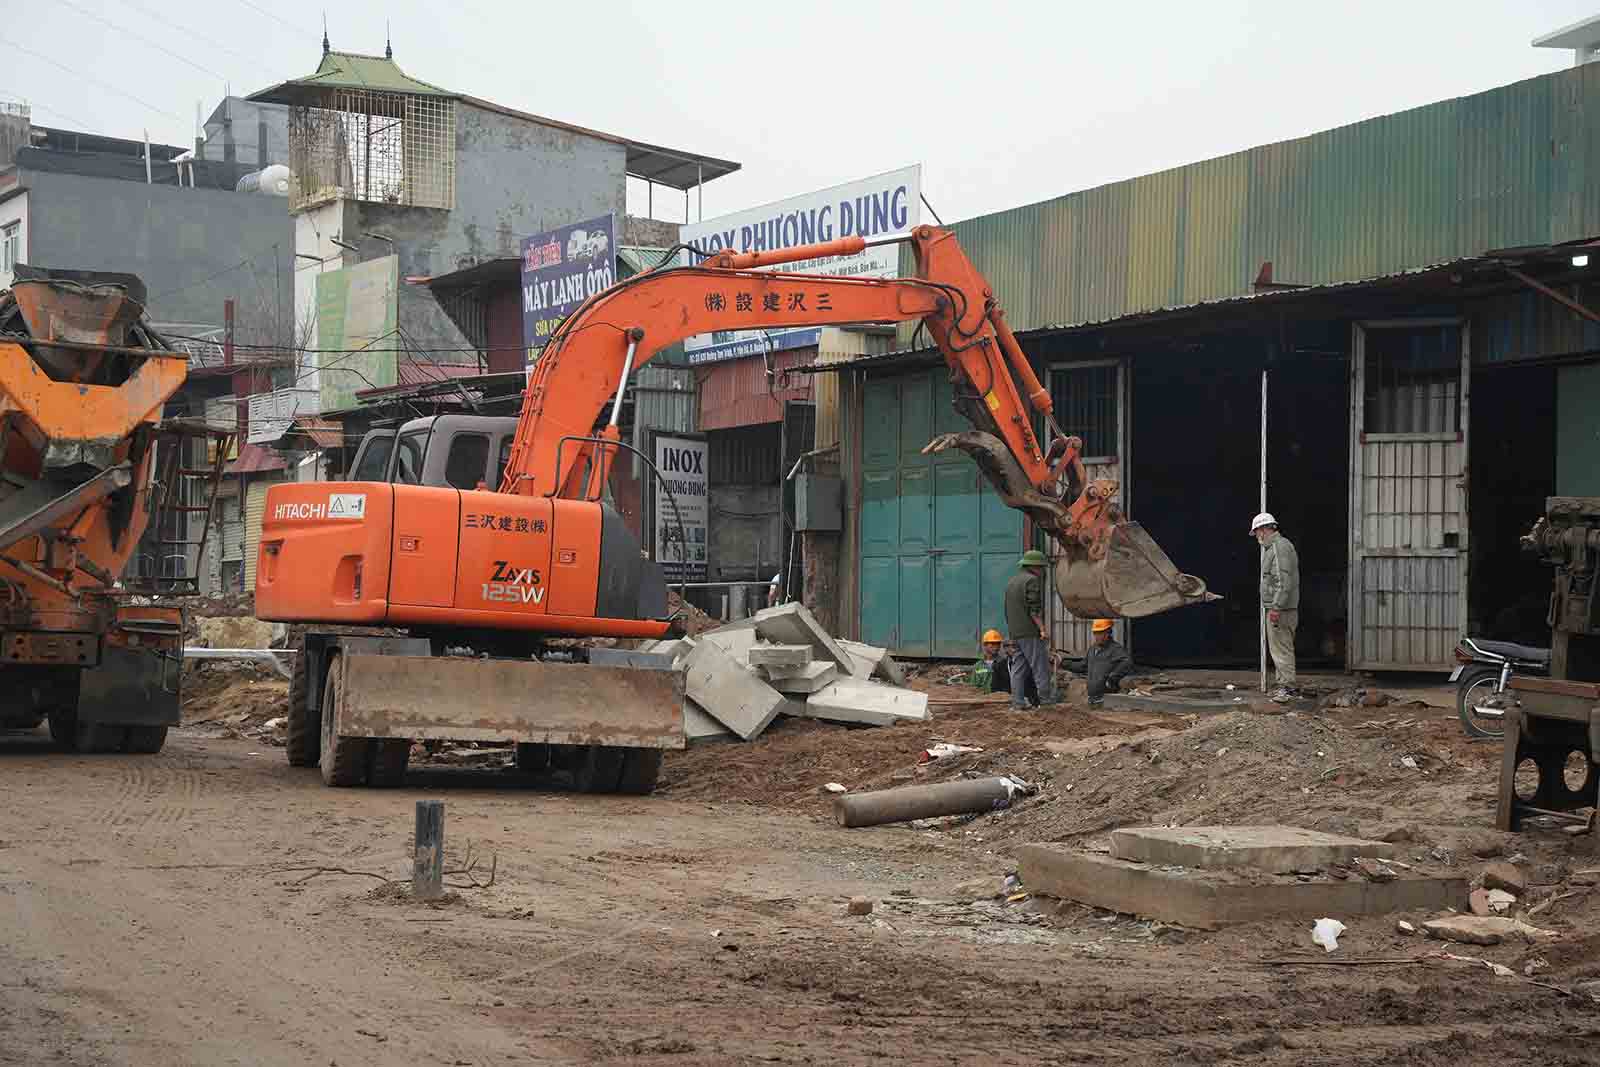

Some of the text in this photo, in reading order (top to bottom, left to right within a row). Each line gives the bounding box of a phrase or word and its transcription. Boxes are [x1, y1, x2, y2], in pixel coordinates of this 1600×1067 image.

[840, 185, 908, 238] DUNG
[524, 275, 549, 313] MÁY
[663, 447, 703, 475] INOX
[274, 503, 326, 519] HITACHI
[491, 560, 541, 585] ZAXIS
[481, 583, 545, 604] 125W
